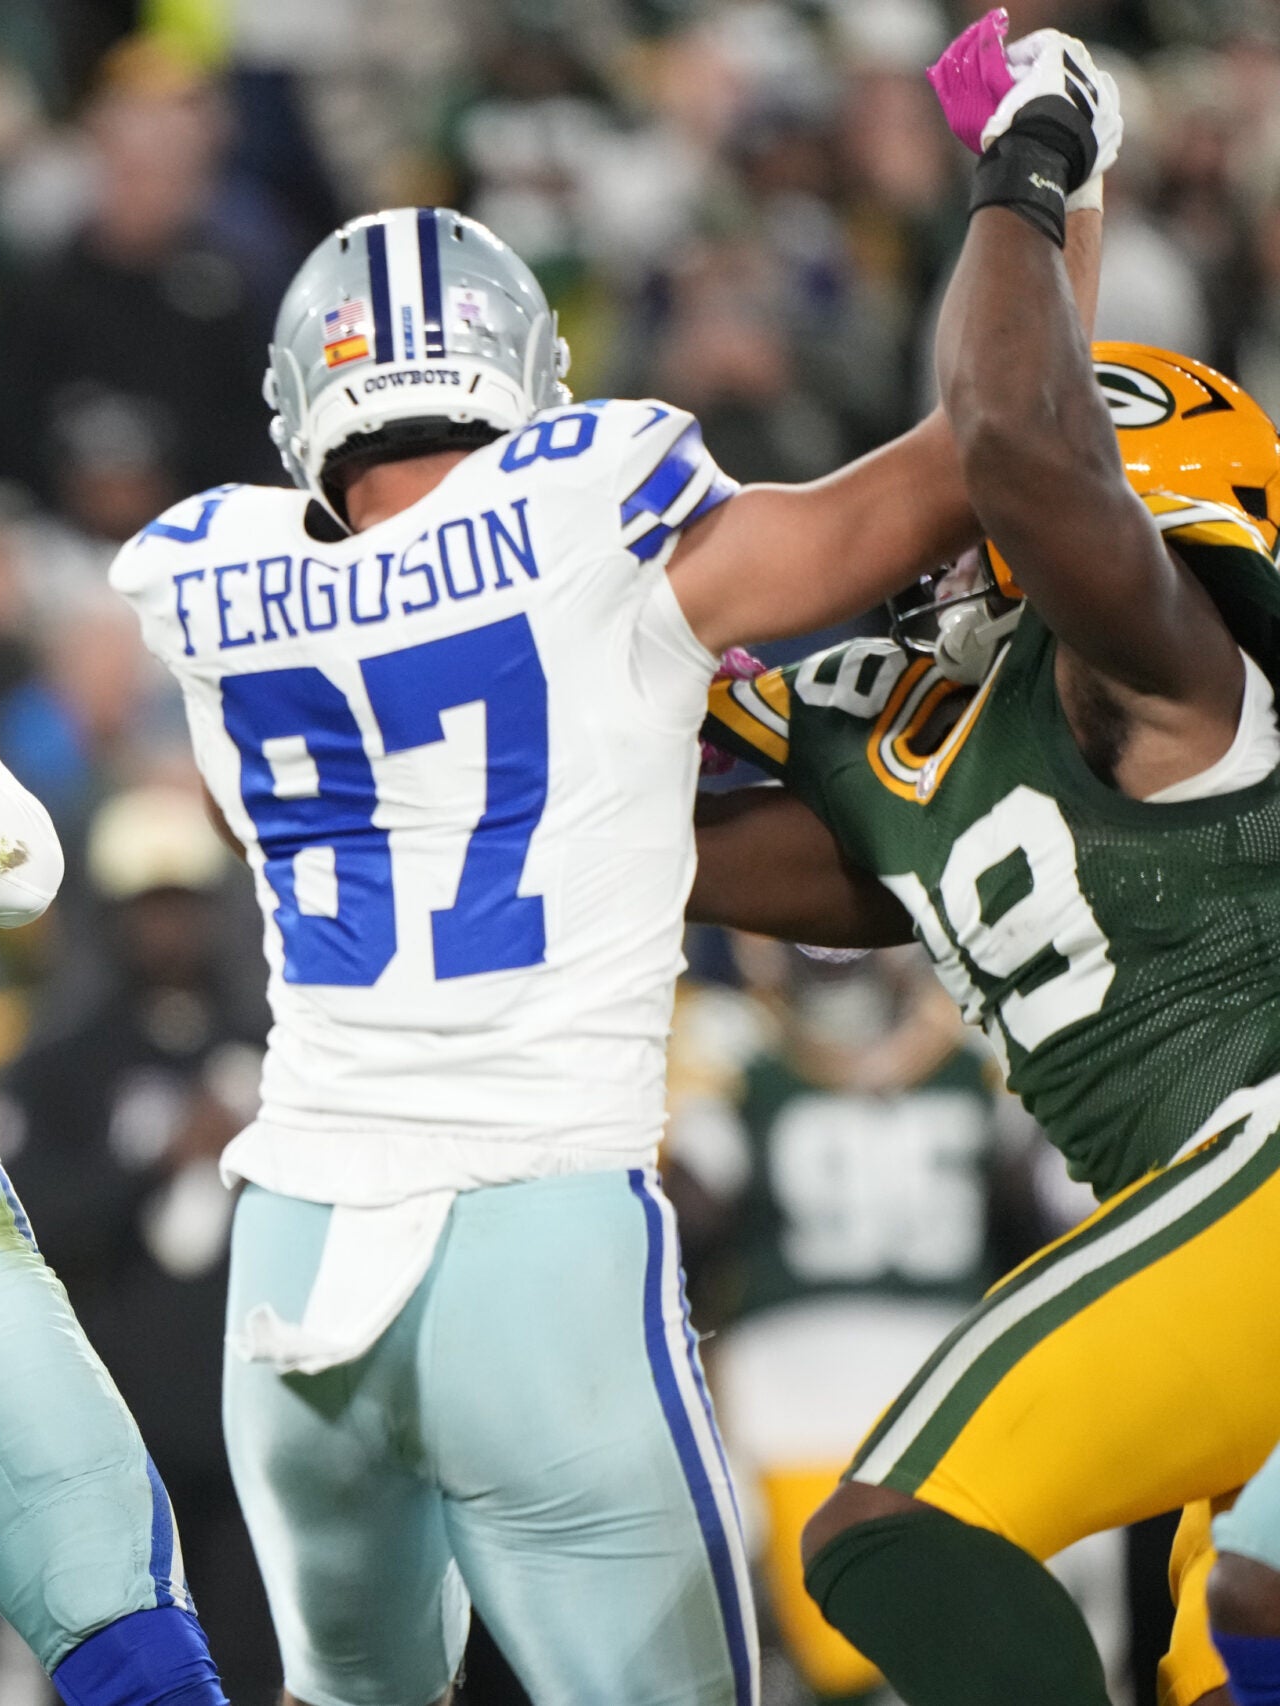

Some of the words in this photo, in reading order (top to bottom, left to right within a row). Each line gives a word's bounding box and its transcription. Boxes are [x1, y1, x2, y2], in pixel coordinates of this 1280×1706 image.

[364, 369, 461, 394] COWBOYS
[172, 497, 541, 657] FERGUSON
[220, 612, 549, 987] 87
